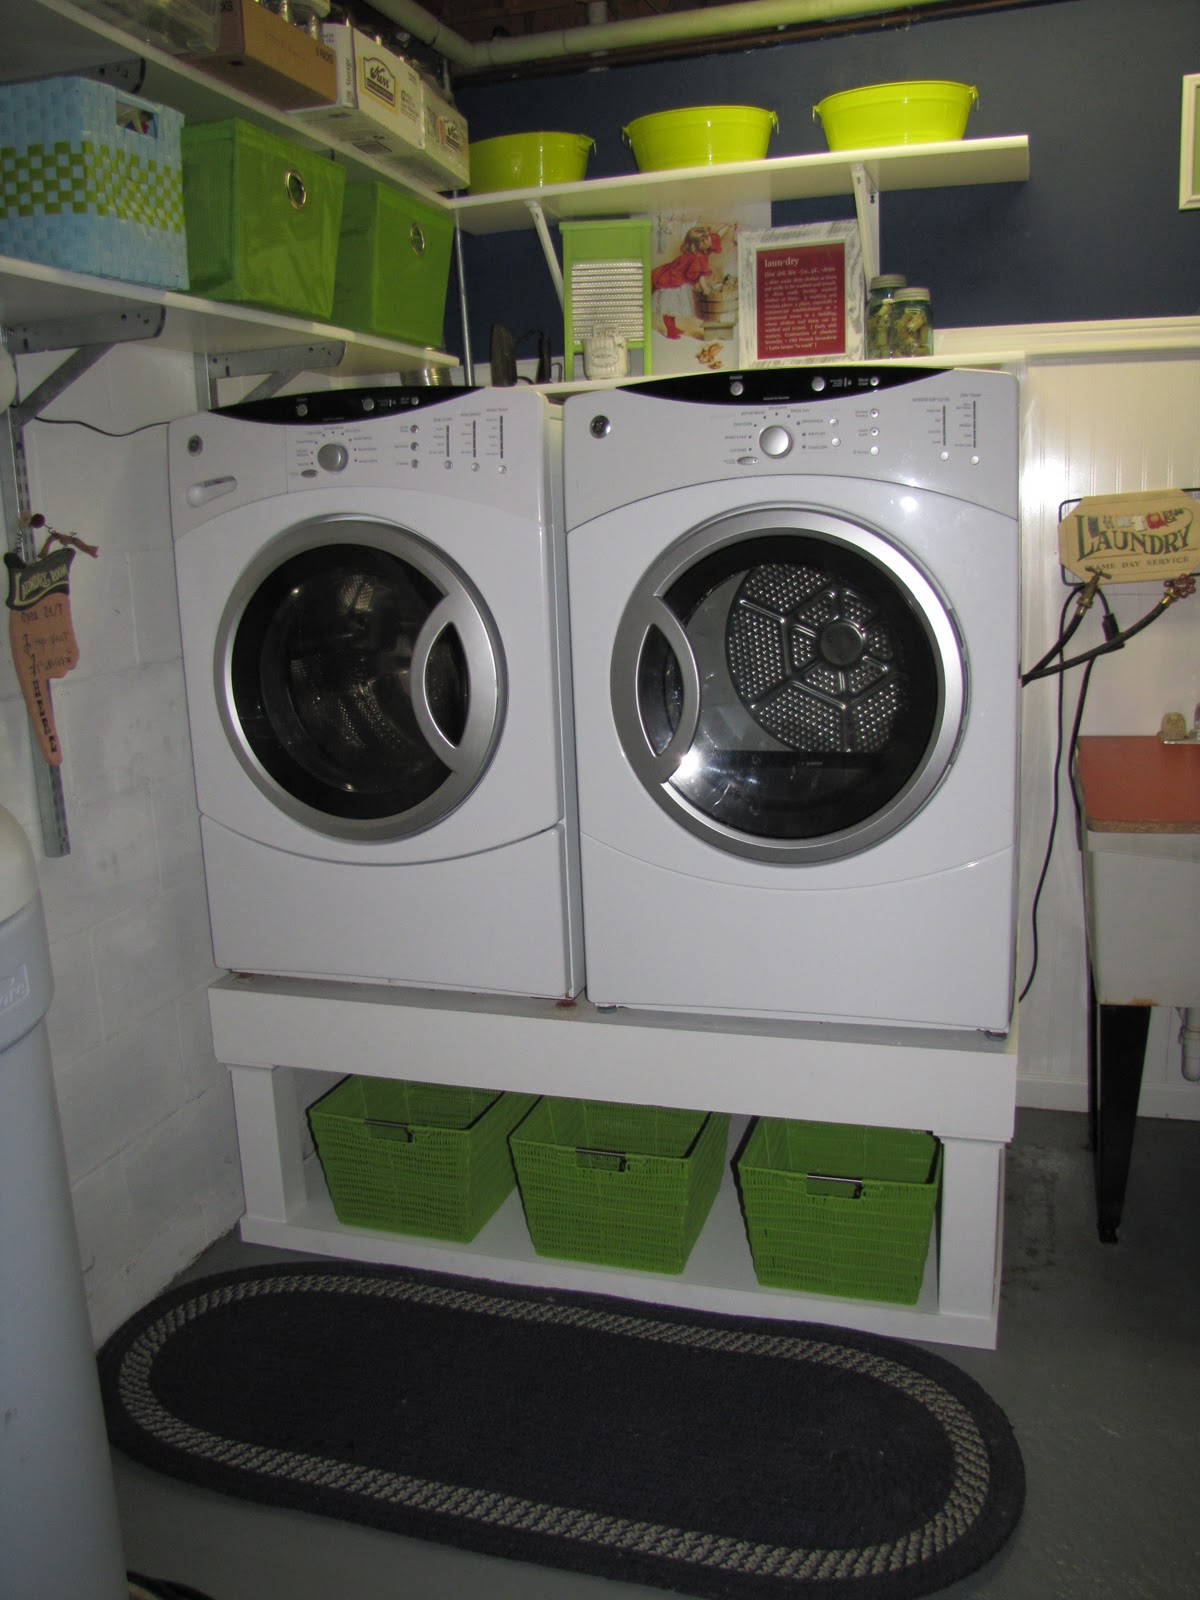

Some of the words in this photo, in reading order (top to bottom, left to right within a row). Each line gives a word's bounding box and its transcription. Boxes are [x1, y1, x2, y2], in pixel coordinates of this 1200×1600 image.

[1074, 514, 1192, 562] LAUNDRY
[1121, 561, 1141, 569] DAY
[1146, 556, 1190, 566] SERVICE
[13, 571, 50, 607] LAUNDRY
[49, 563, 69, 583] ROOM
